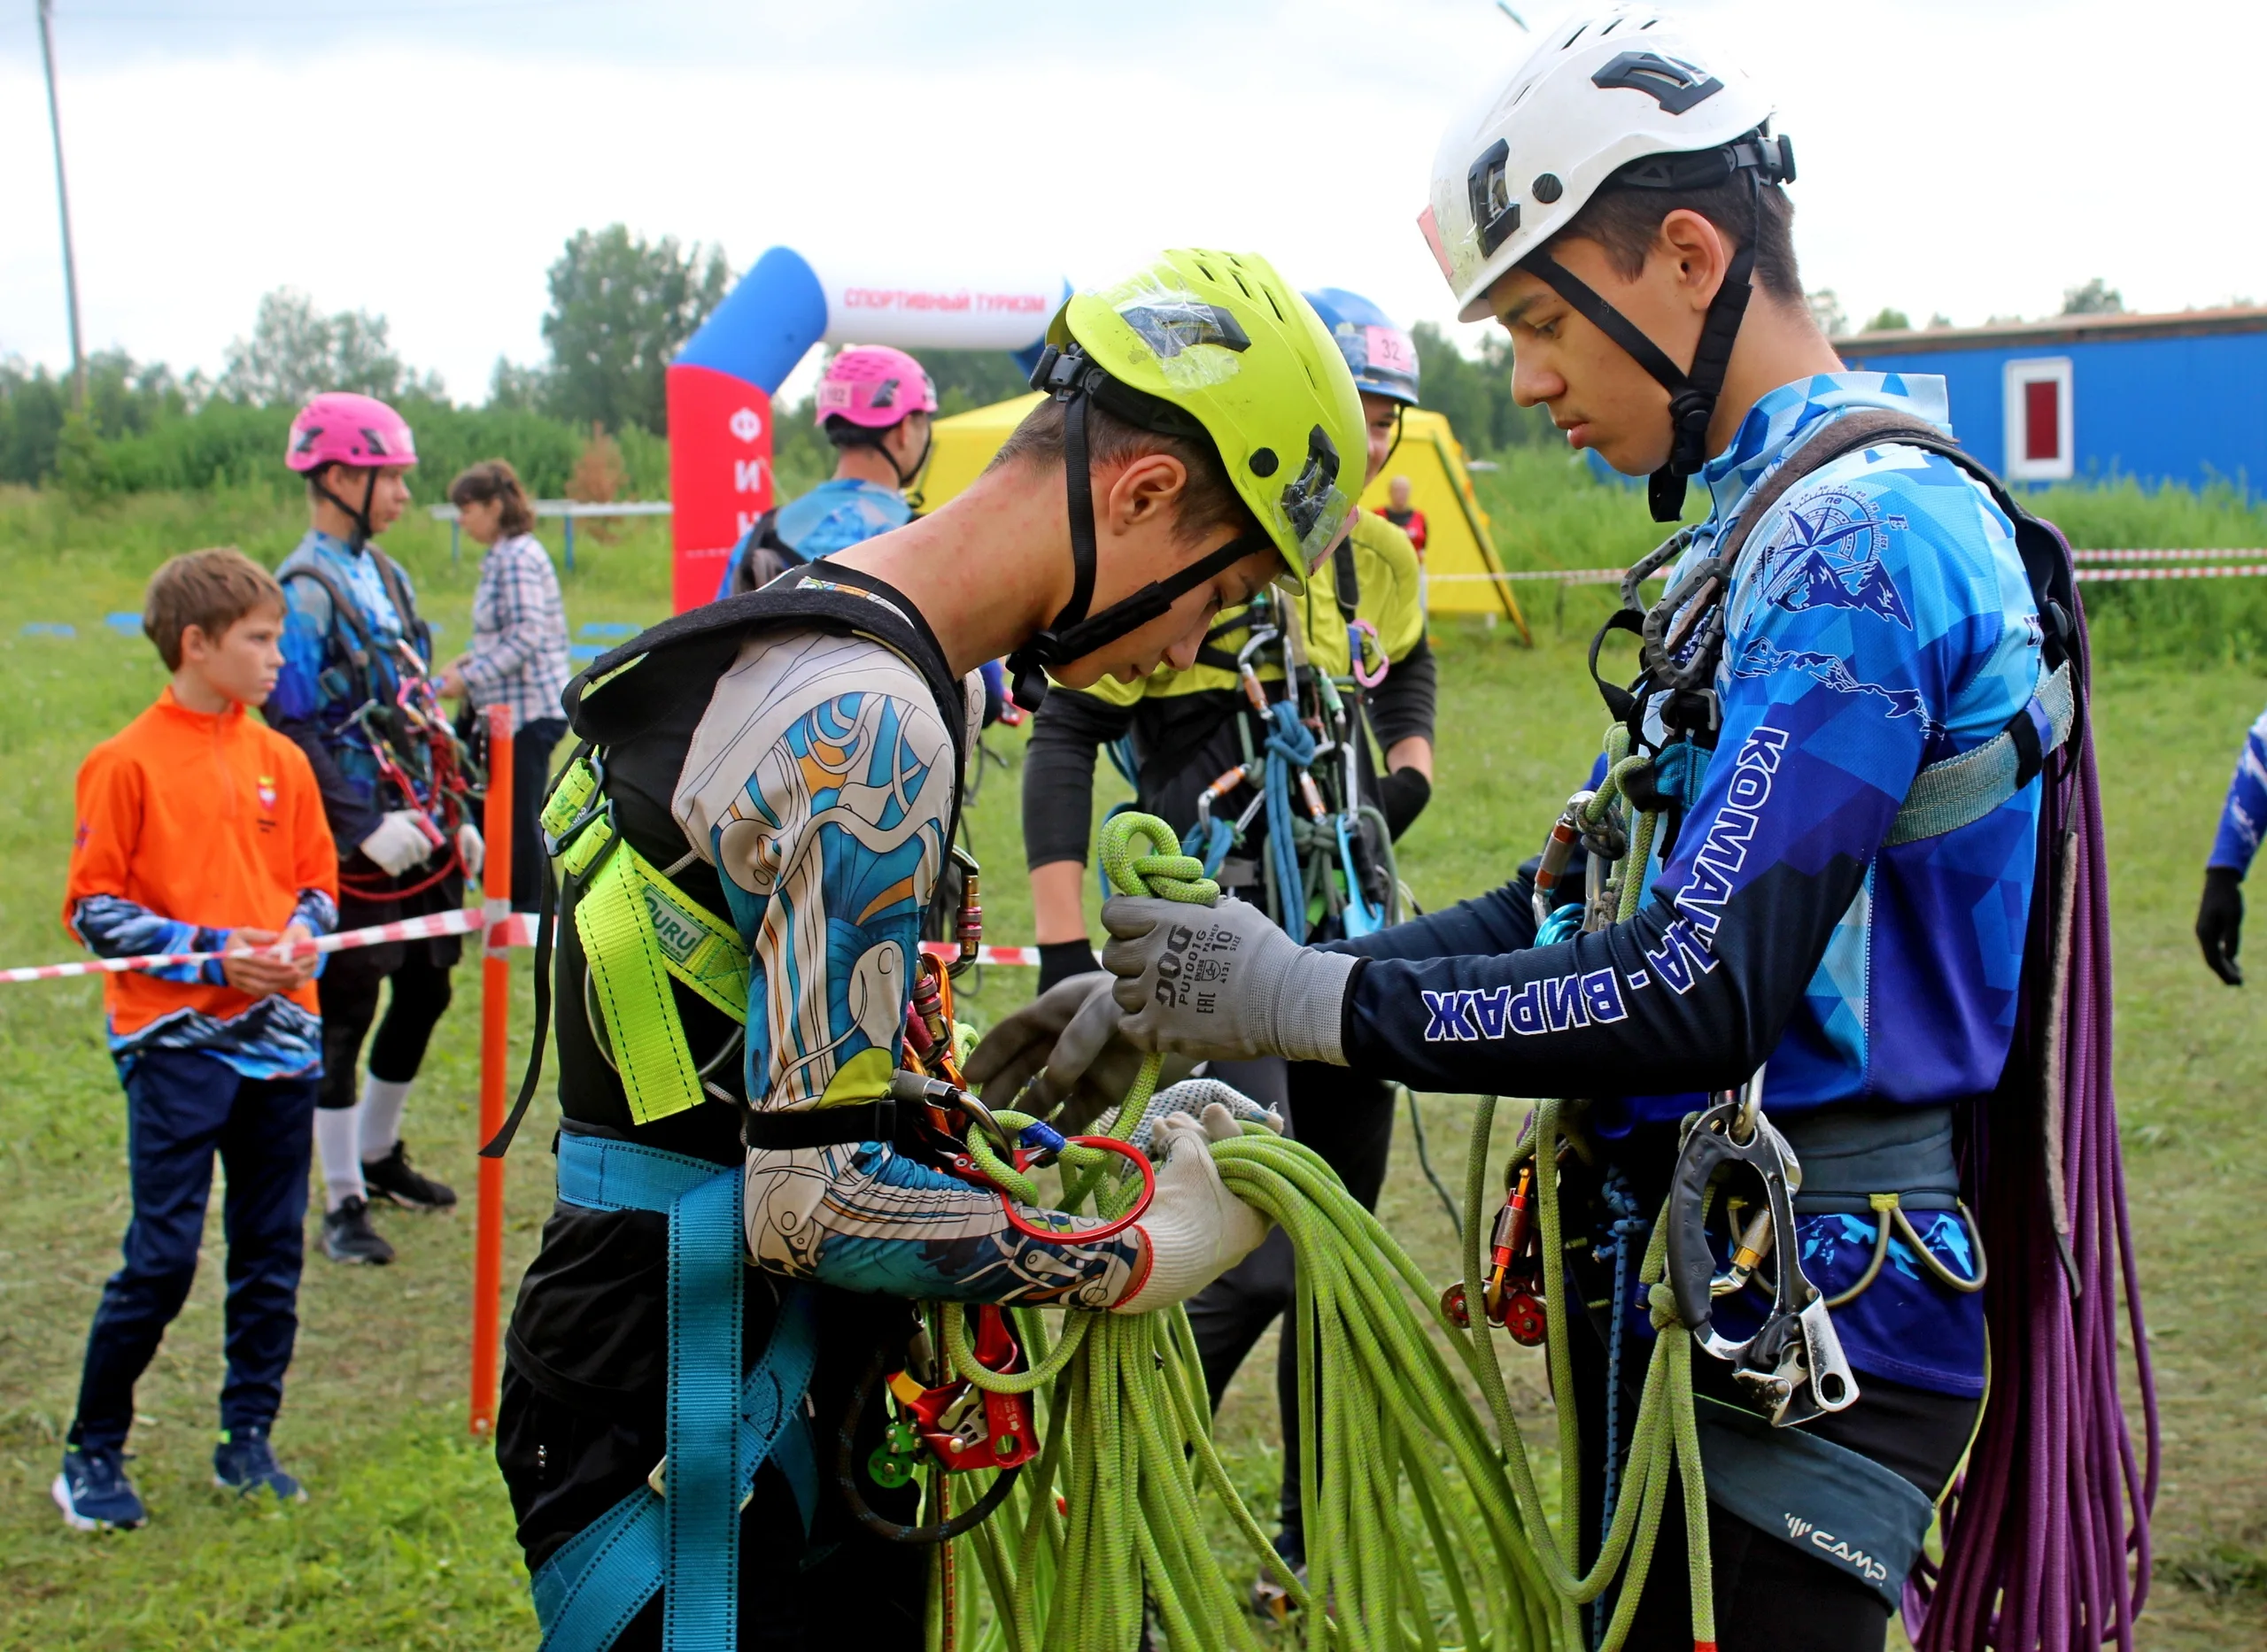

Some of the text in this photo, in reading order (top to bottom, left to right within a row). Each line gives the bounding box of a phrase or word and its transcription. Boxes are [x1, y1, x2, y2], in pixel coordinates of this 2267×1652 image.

[845, 288, 1047, 313] СПОРТИВНЫЙ ТУРИЗМ
[1381, 338, 1401, 361] 32
[1645, 726, 1790, 995] КОМАНДА
[1211, 930, 1233, 952] 10
[1229, 936, 1242, 952] SIZE
[1155, 923, 1194, 1009] DOG
[1179, 930, 1207, 1006] PU1001G
[1219, 961, 1231, 984] 4131
[1421, 967, 1629, 1042] ВИРАЖ
[1811, 1530, 1887, 1580] CAMP
